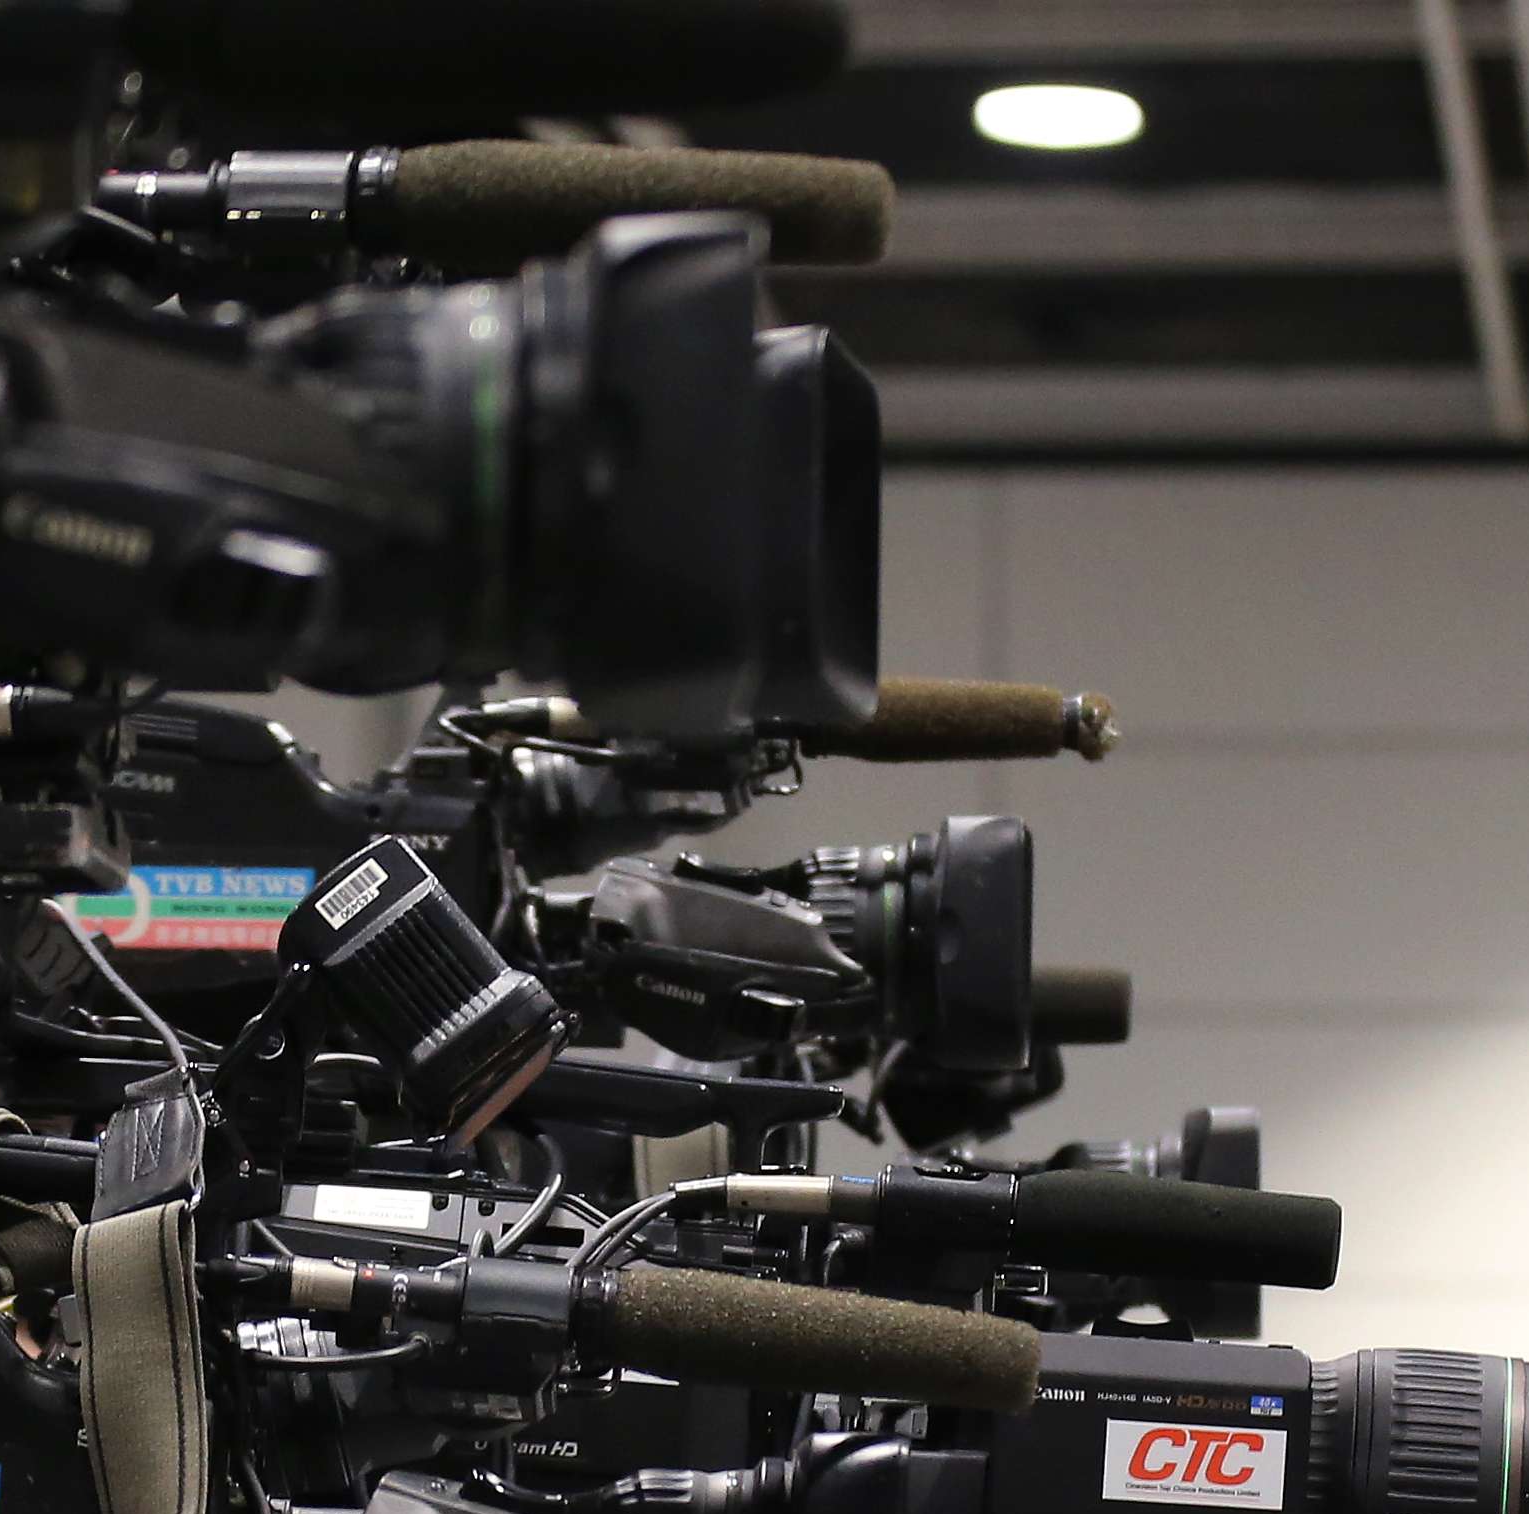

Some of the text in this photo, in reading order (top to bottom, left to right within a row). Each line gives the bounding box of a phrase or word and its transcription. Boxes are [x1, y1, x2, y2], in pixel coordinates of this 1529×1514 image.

[156, 872, 306, 896] TVB NEWS
[634, 973, 706, 1006] Canon
[550, 1440, 578, 1457] HD
[1128, 1427, 1265, 1486] CTC
